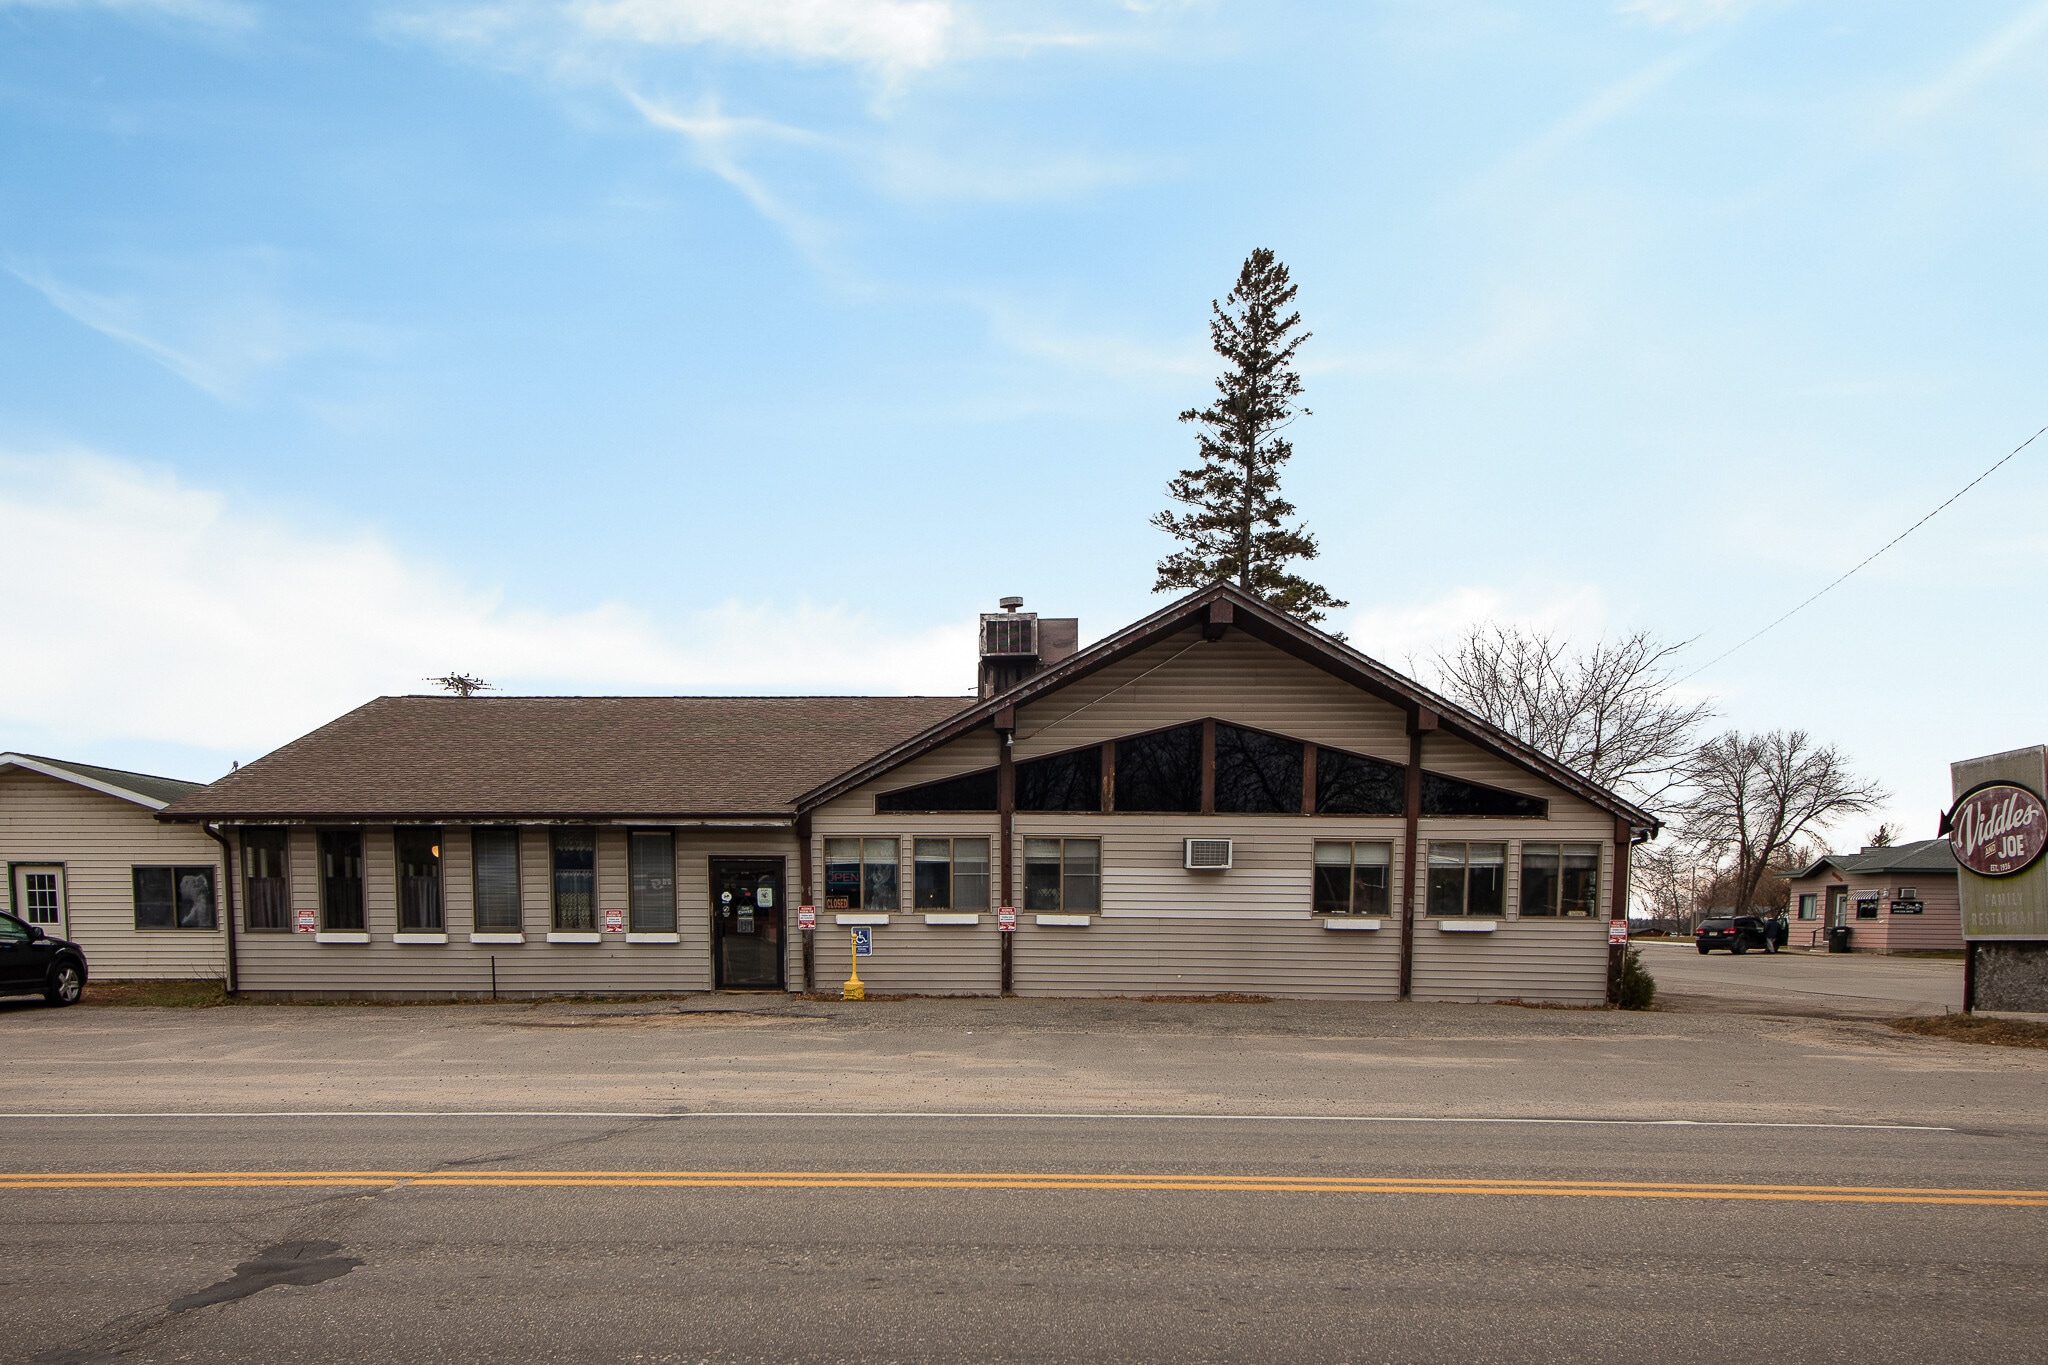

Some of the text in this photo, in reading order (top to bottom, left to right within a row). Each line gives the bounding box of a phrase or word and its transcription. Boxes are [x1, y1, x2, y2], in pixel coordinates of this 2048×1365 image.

[1957, 793, 2039, 856] Viddles
[1985, 835, 2025, 859] AND JOE
[825, 873, 859, 882] OPEN
[826, 898, 848, 909] CLOSED
[1984, 892, 2023, 907] FAMILY
[1971, 911, 2042, 926] RESTAURANT
